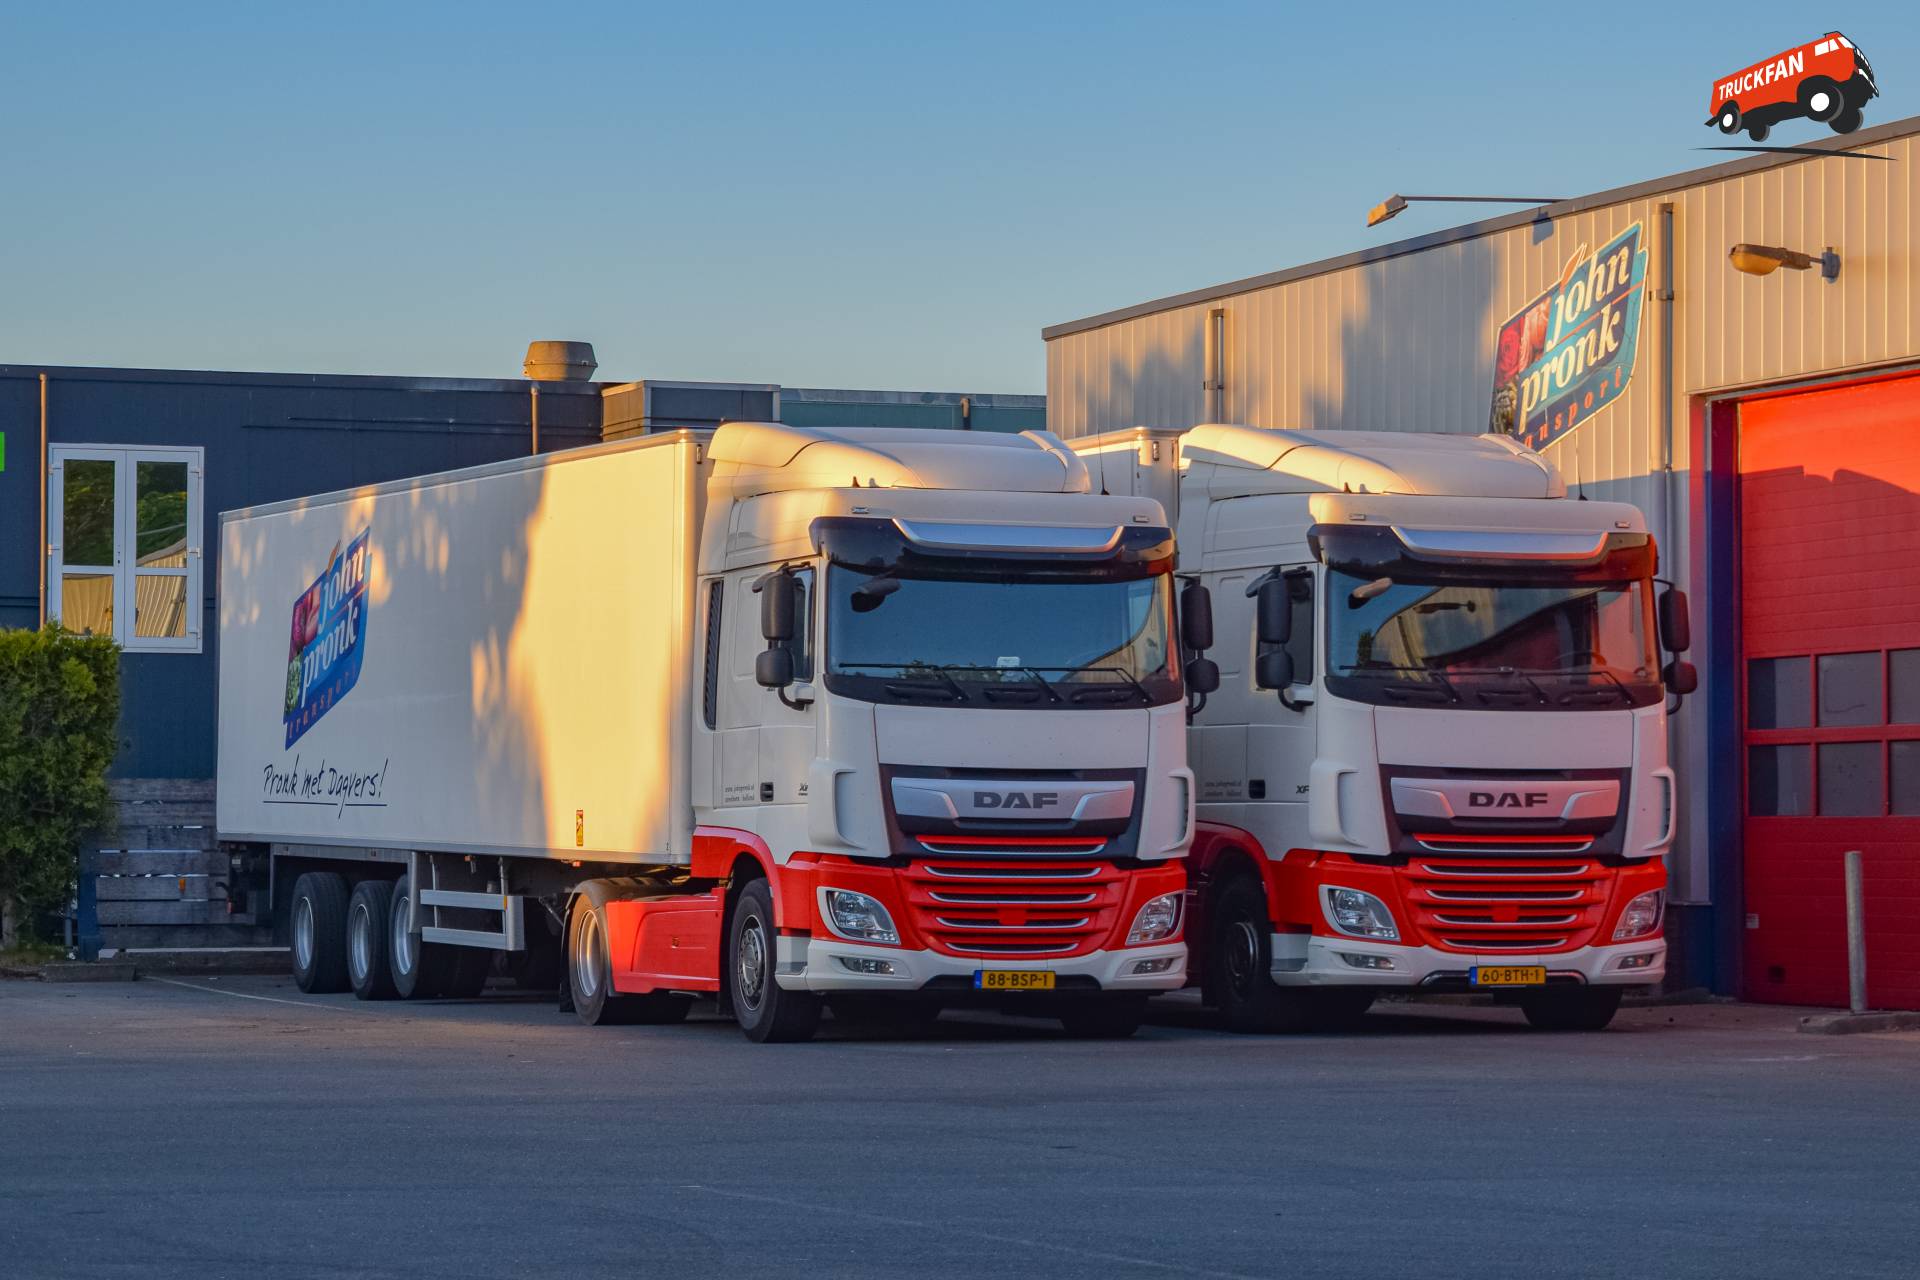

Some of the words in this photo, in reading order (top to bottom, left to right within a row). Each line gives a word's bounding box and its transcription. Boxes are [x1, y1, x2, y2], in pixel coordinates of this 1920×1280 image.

[1546, 245, 1630, 353] john
[1518, 302, 1621, 435] pronk
[1524, 366, 1622, 449] ansport
[317, 545, 364, 635] john
[301, 598, 358, 708] pronk
[263, 753, 299, 797] Pronk
[302, 759, 325, 799] met
[973, 791, 1058, 809] DAF
[1468, 792, 1548, 808] DAF
[987, 973, 1048, 986] 88-BSP-1
[1482, 969, 1539, 982] 60-BTH-1
